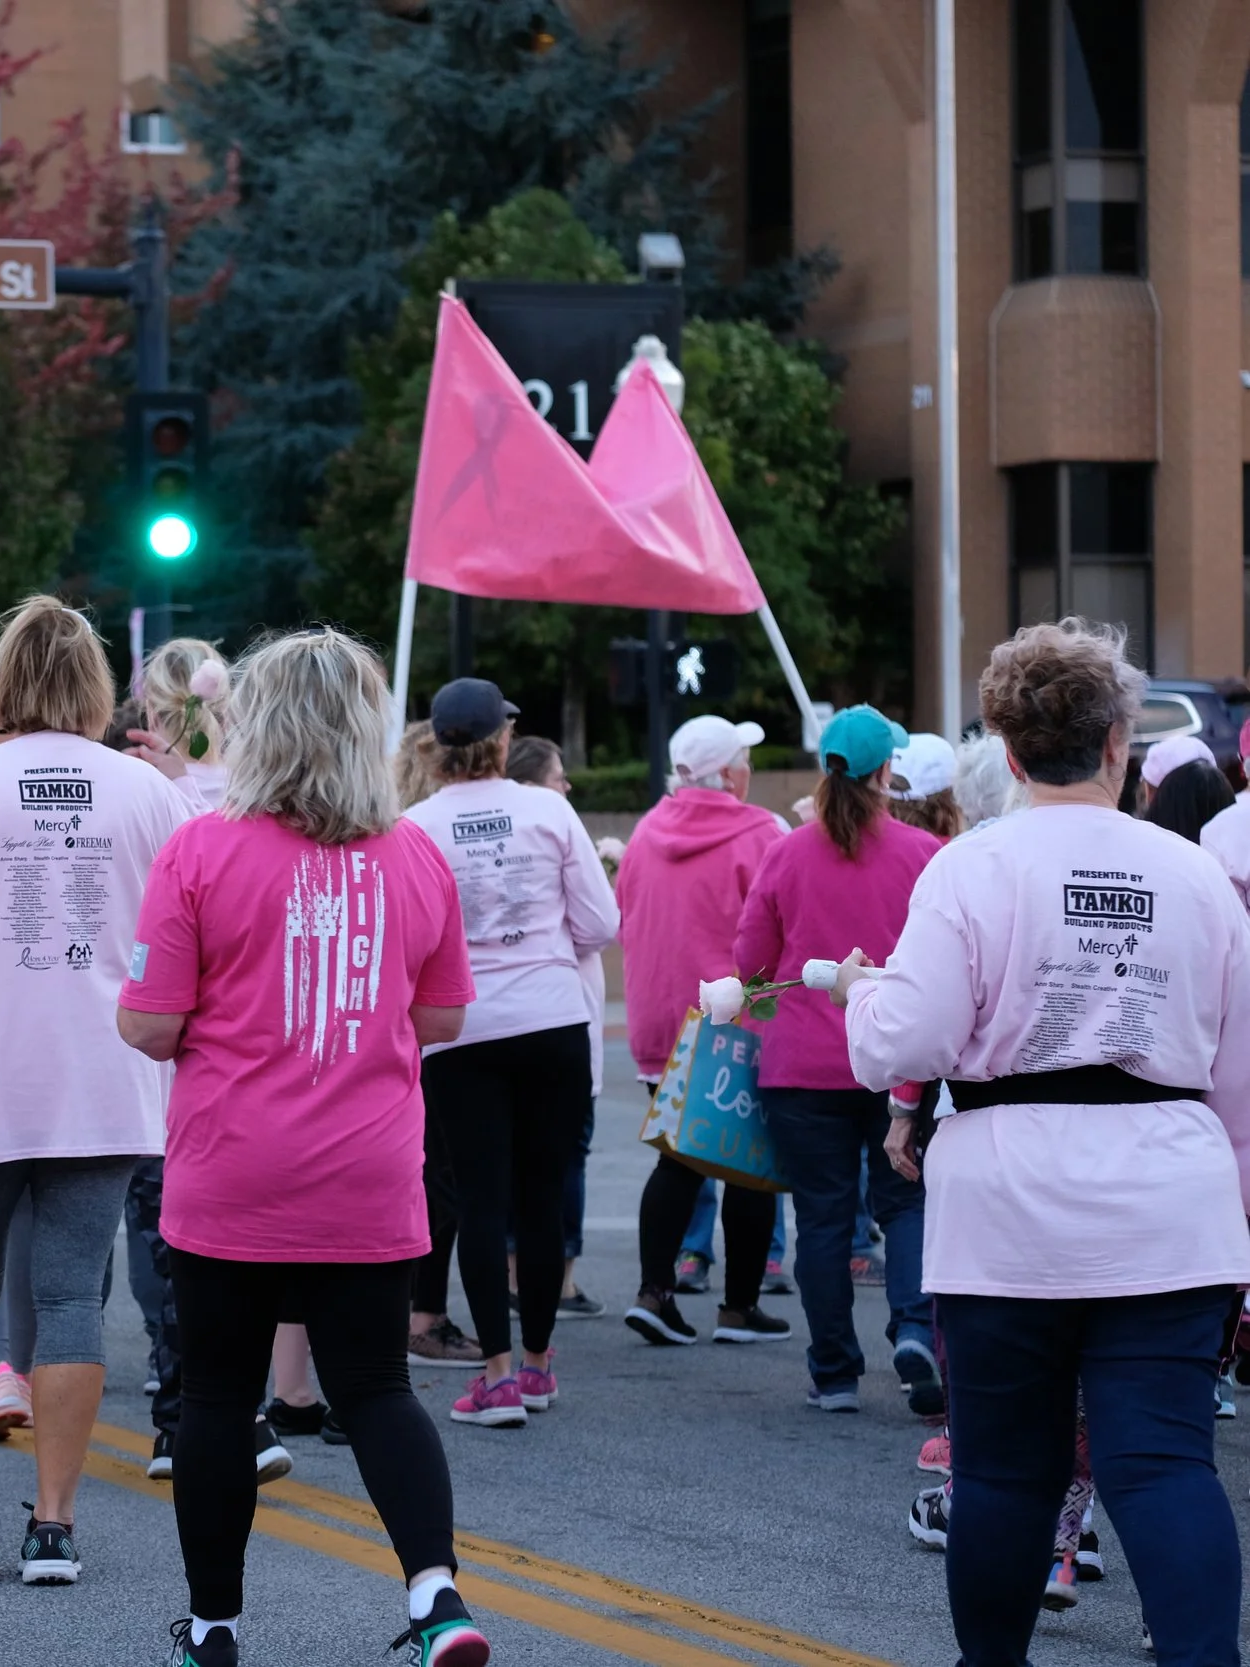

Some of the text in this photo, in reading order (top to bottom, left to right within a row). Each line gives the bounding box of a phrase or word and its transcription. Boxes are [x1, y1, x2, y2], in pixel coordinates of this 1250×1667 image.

[24, 767, 83, 775] PRESENTED BY
[24, 783, 87, 799] TAMKO
[21, 804, 93, 812] BUILDING PRODUCTS
[34, 819, 72, 834] Mercy
[458, 819, 507, 836] TAMKO
[75, 837, 113, 849] FREEMAN
[1071, 869, 1143, 883] PRESENTED BY
[1070, 890, 1146, 916] TAMKO
[1064, 917, 1153, 933] BUILDING PRODUCTS
[345, 851, 370, 1053] FIGHT
[1078, 937, 1126, 959] Mercy
[1128, 963, 1168, 984] FREEMAN
[1092, 984, 1118, 993] Creative
